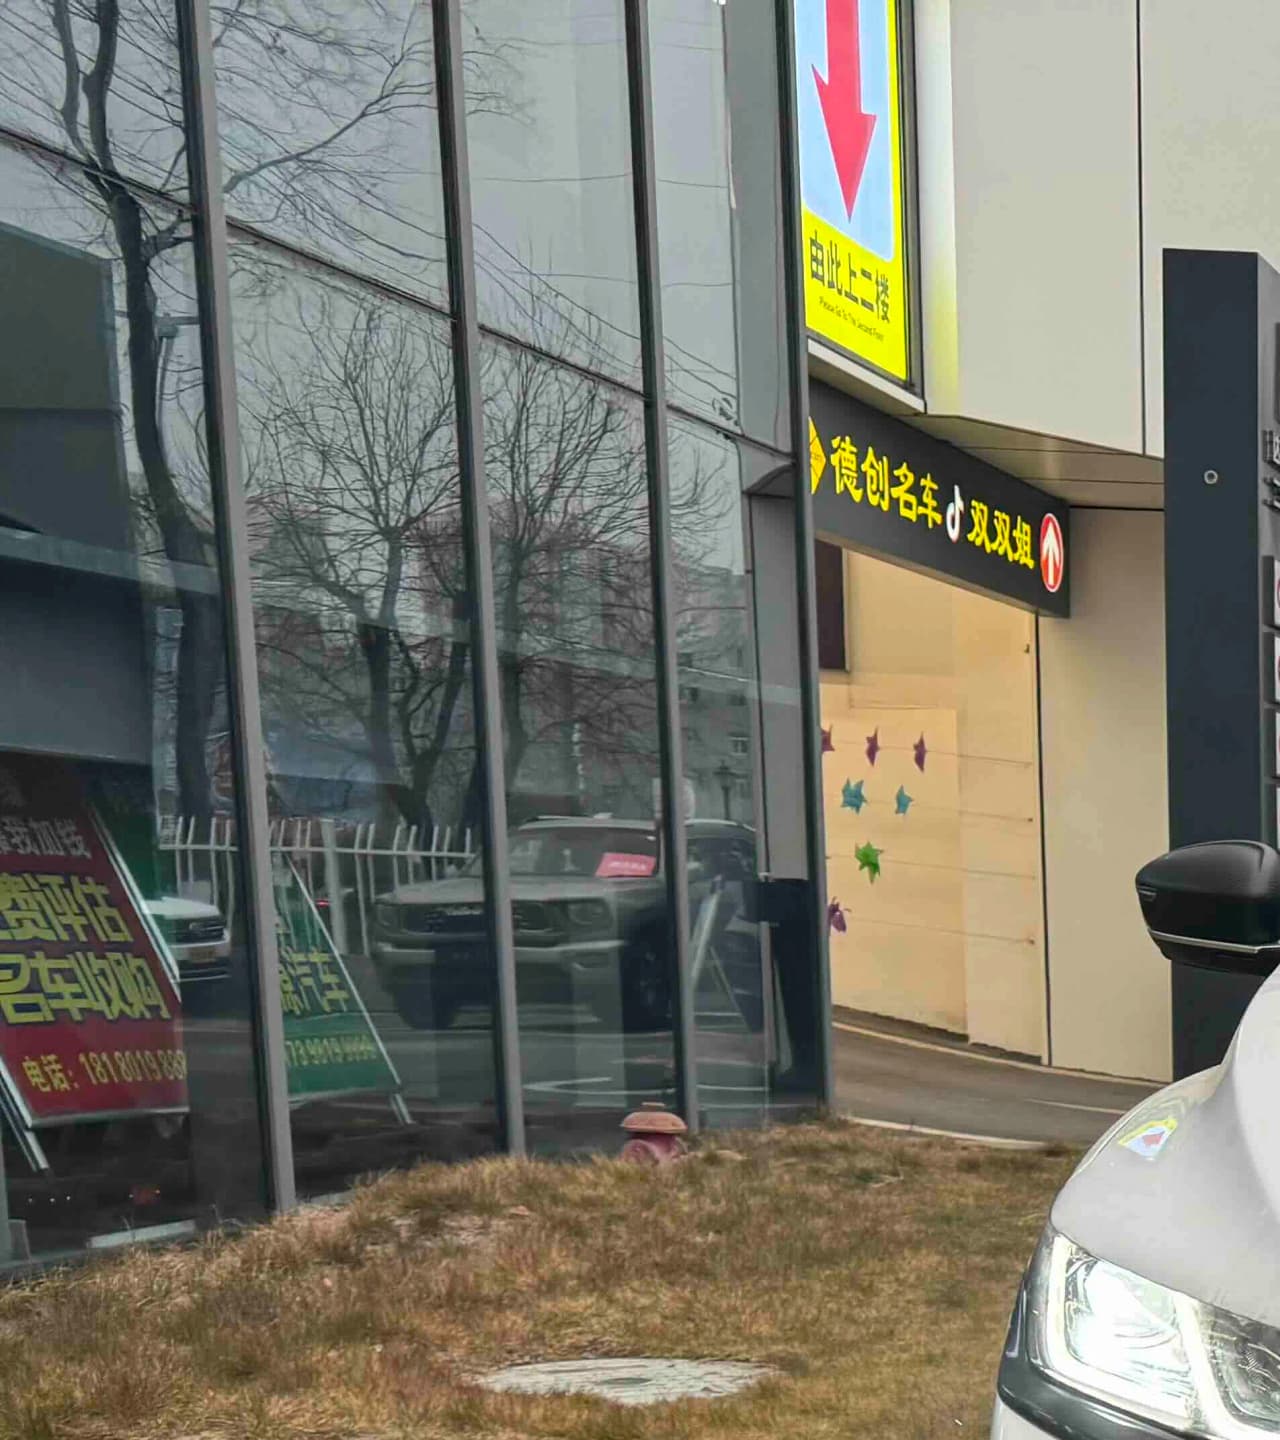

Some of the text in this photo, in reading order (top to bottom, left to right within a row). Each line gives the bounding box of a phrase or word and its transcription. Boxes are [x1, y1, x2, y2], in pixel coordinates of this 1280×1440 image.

[809, 229, 890, 324] 由此上二楼
[831, 436, 1035, 569] 德创名车 双双姐
[0, 872, 135, 943] 费评估
[0, 950, 172, 1025] 名车收购
